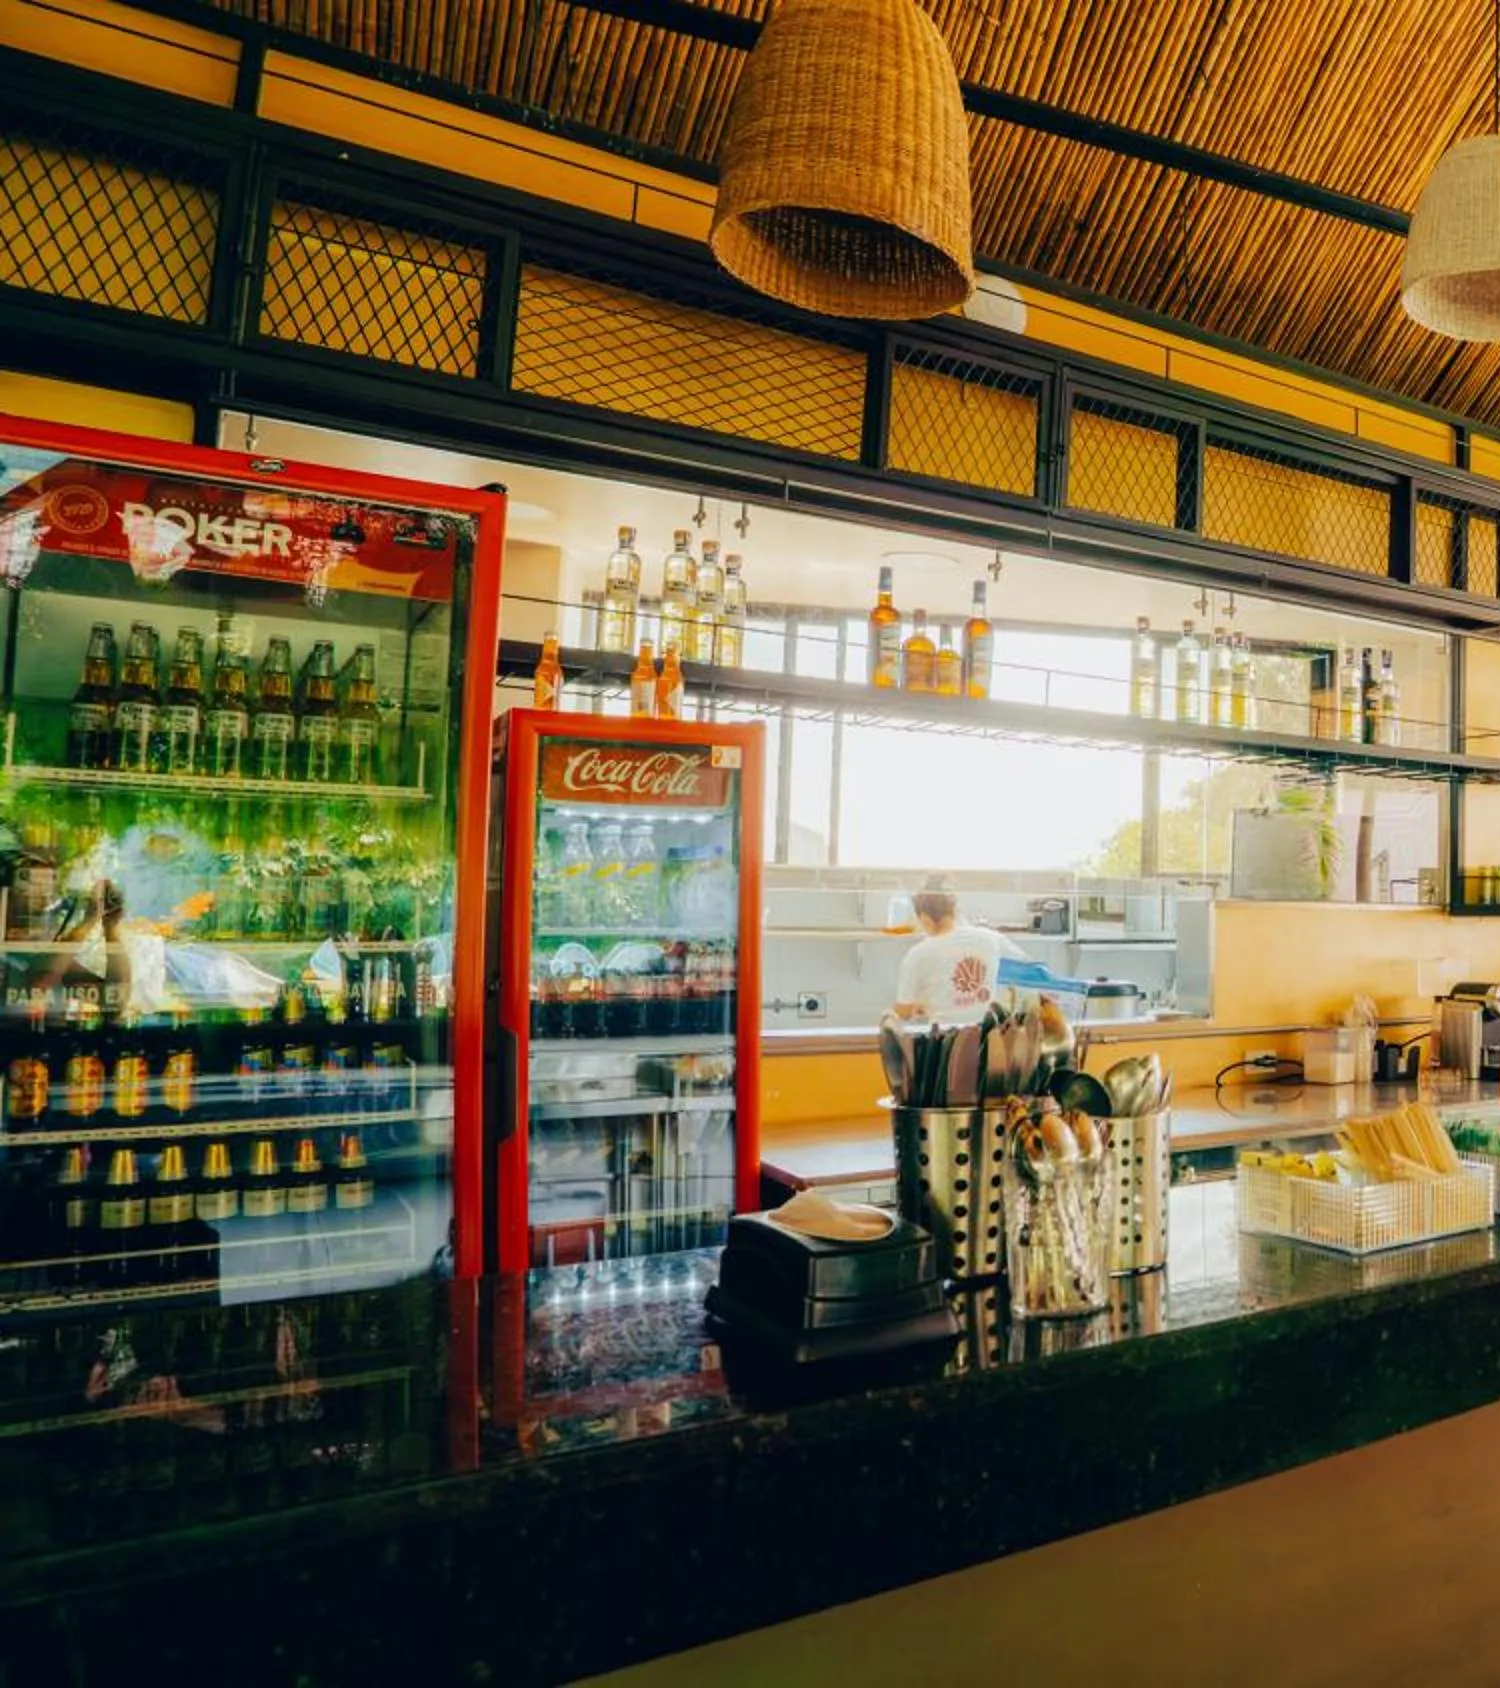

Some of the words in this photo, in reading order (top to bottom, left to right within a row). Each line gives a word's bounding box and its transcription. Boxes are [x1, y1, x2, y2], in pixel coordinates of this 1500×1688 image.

[123, 502, 293, 557] POKER
[564, 748, 704, 794] Coca-Cola
[6, 986, 55, 1006] PARA
